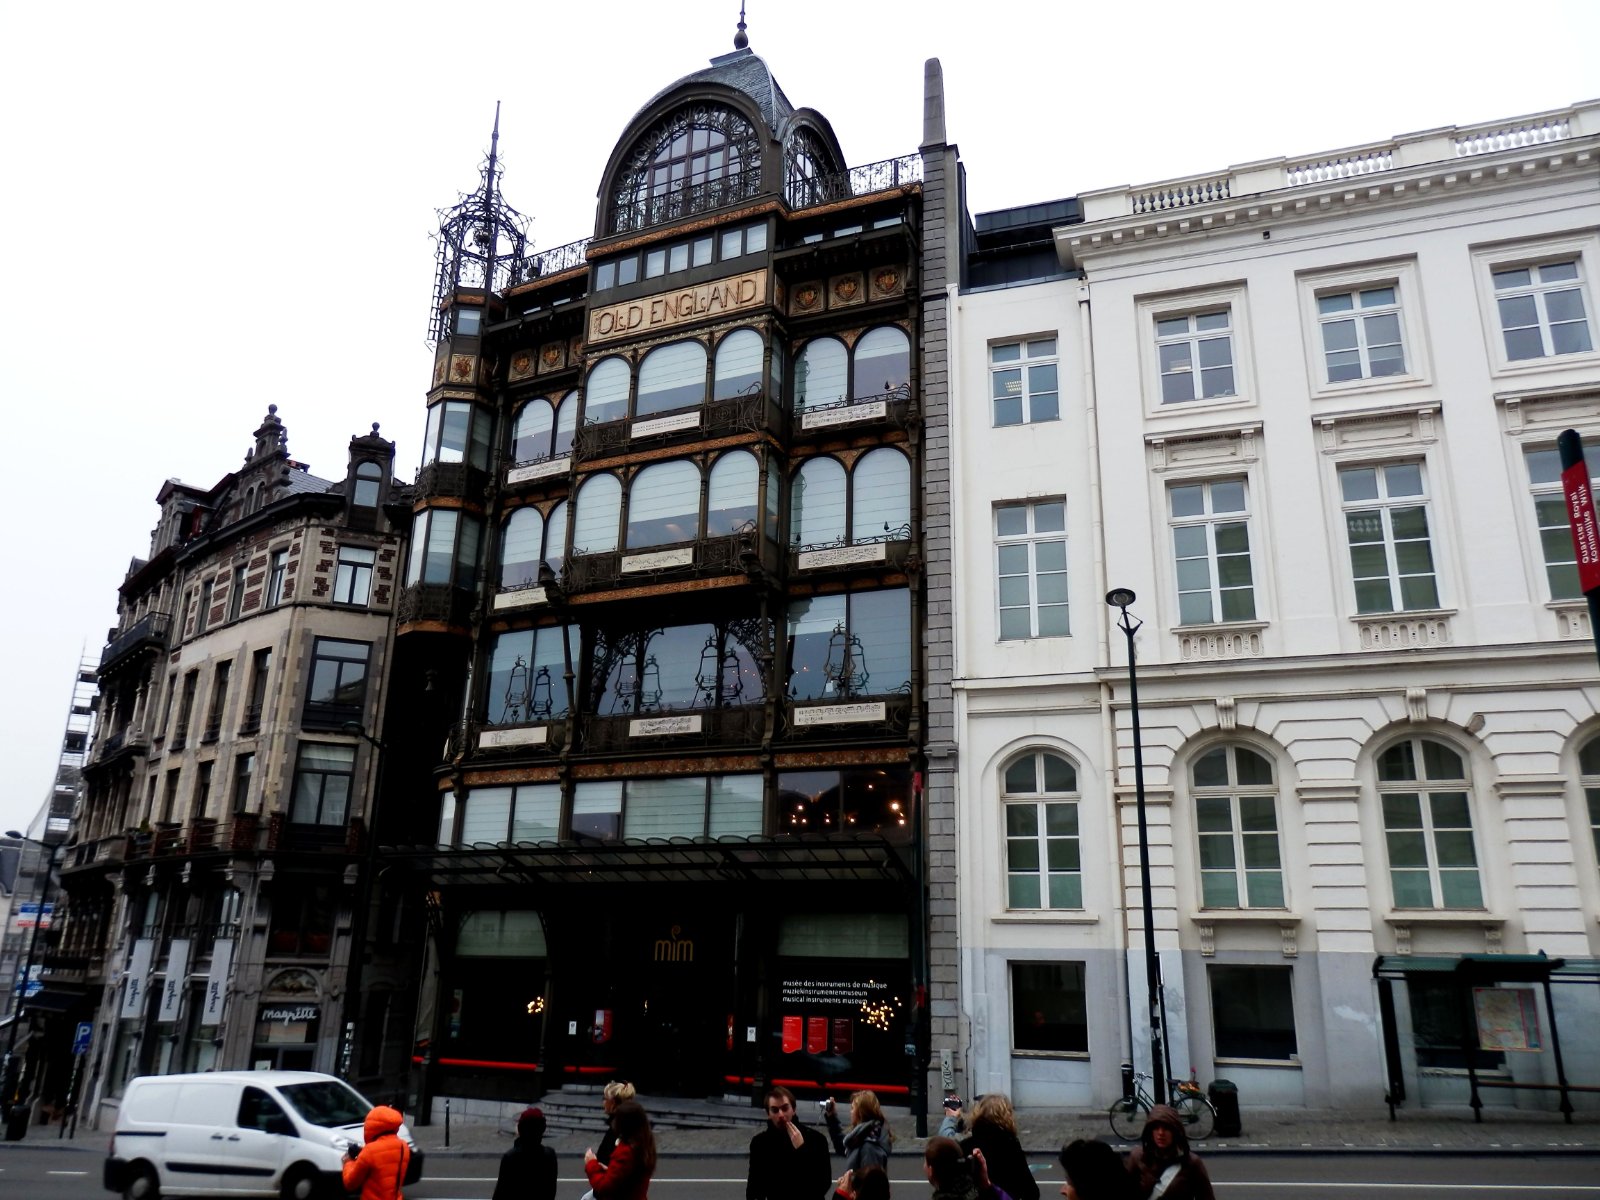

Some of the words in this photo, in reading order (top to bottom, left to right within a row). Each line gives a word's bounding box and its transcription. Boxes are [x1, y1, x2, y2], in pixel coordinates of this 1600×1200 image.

[599, 305, 643, 335] OLD
[650, 279, 757, 324] ENGLAND
[1570, 491, 1581, 518] Royal
[1576, 523, 1590, 564] Quartier
[654, 925, 694, 962] mim
[861, 982, 888, 990] musique
[806, 996, 841, 1004] instruments
[262, 1007, 317, 1026] magritte
[77, 1025, 91, 1041] P
